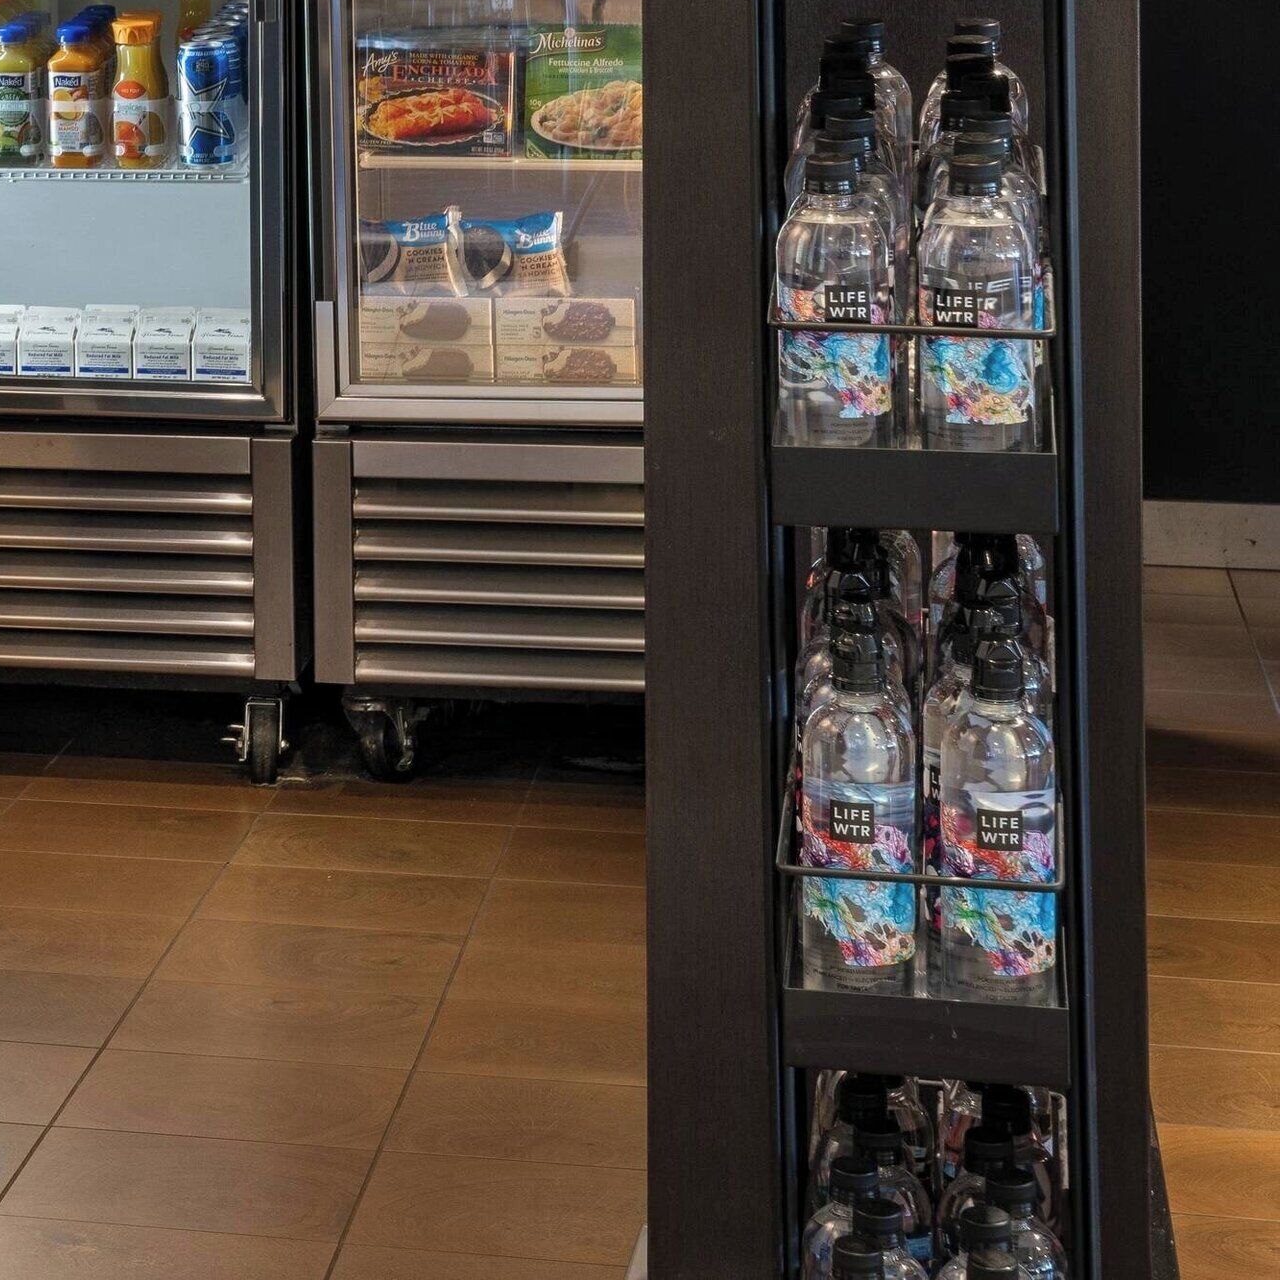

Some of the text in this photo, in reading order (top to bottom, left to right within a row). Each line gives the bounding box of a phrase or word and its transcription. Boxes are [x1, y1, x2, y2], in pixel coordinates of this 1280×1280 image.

[529, 32, 602, 54] Michelina's
[362, 51, 400, 77] Amy's
[548, 58, 624, 66] Fettuccine Alfredo
[55, 77, 79, 86] Naked
[393, 64, 498, 86] ENCHILADA
[402, 222, 437, 242] Blue
[406, 248, 443, 257] COOKIES
[416, 256, 445, 264] CREAM
[829, 291, 866, 303] LIFE
[936, 294, 973, 308] LIFE
[829, 307, 867, 318] WTR
[936, 311, 974, 323] WTR
[833, 806, 870, 822] LIFE
[981, 815, 1020, 829] LIFE
[833, 822, 871, 837] WTR
[981, 832, 1020, 845] WTR
